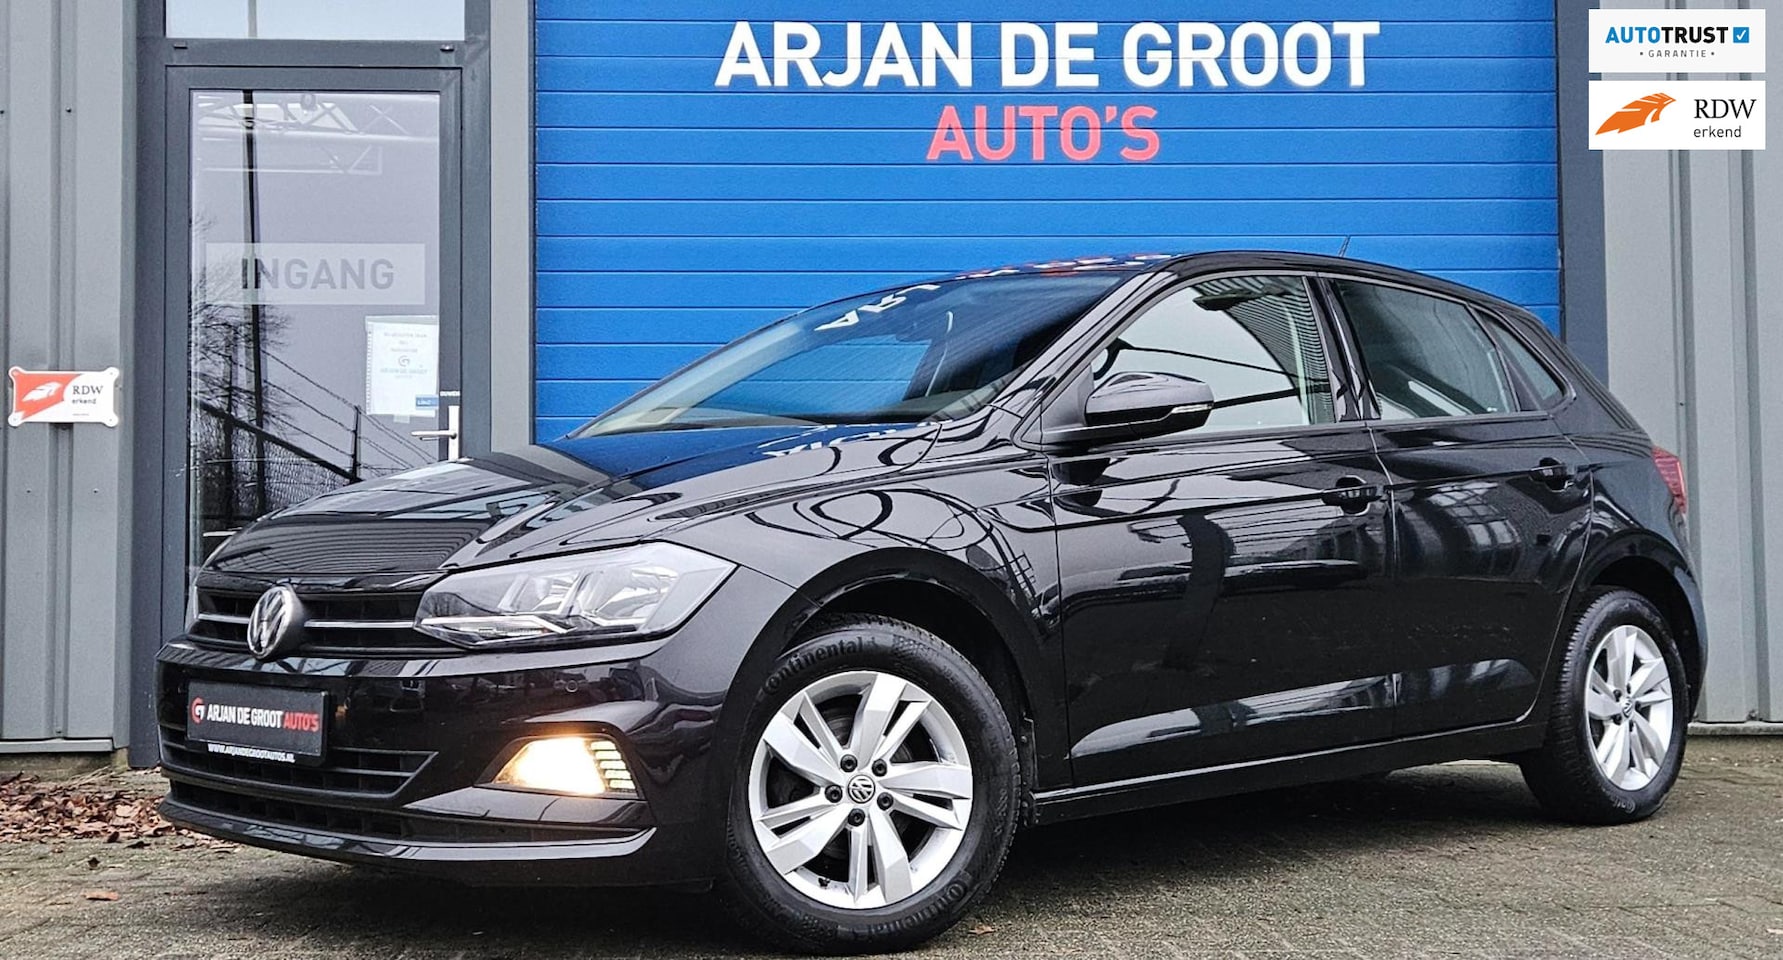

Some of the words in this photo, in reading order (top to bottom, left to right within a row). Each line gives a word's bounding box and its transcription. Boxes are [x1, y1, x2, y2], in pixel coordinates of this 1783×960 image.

[715, 21, 972, 88] ARJAN
[1001, 21, 1099, 88] DE
[1122, 20, 1380, 88] GROOT
[926, 105, 1161, 161] AUTO'S
[241, 258, 394, 290] INGANG
[72, 385, 104, 396] RDW
[206, 703, 237, 724] ARJAN
[236, 706, 251, 726] DE
[250, 708, 284, 729] GROOT
[283, 711, 320, 732] AUTO'S
